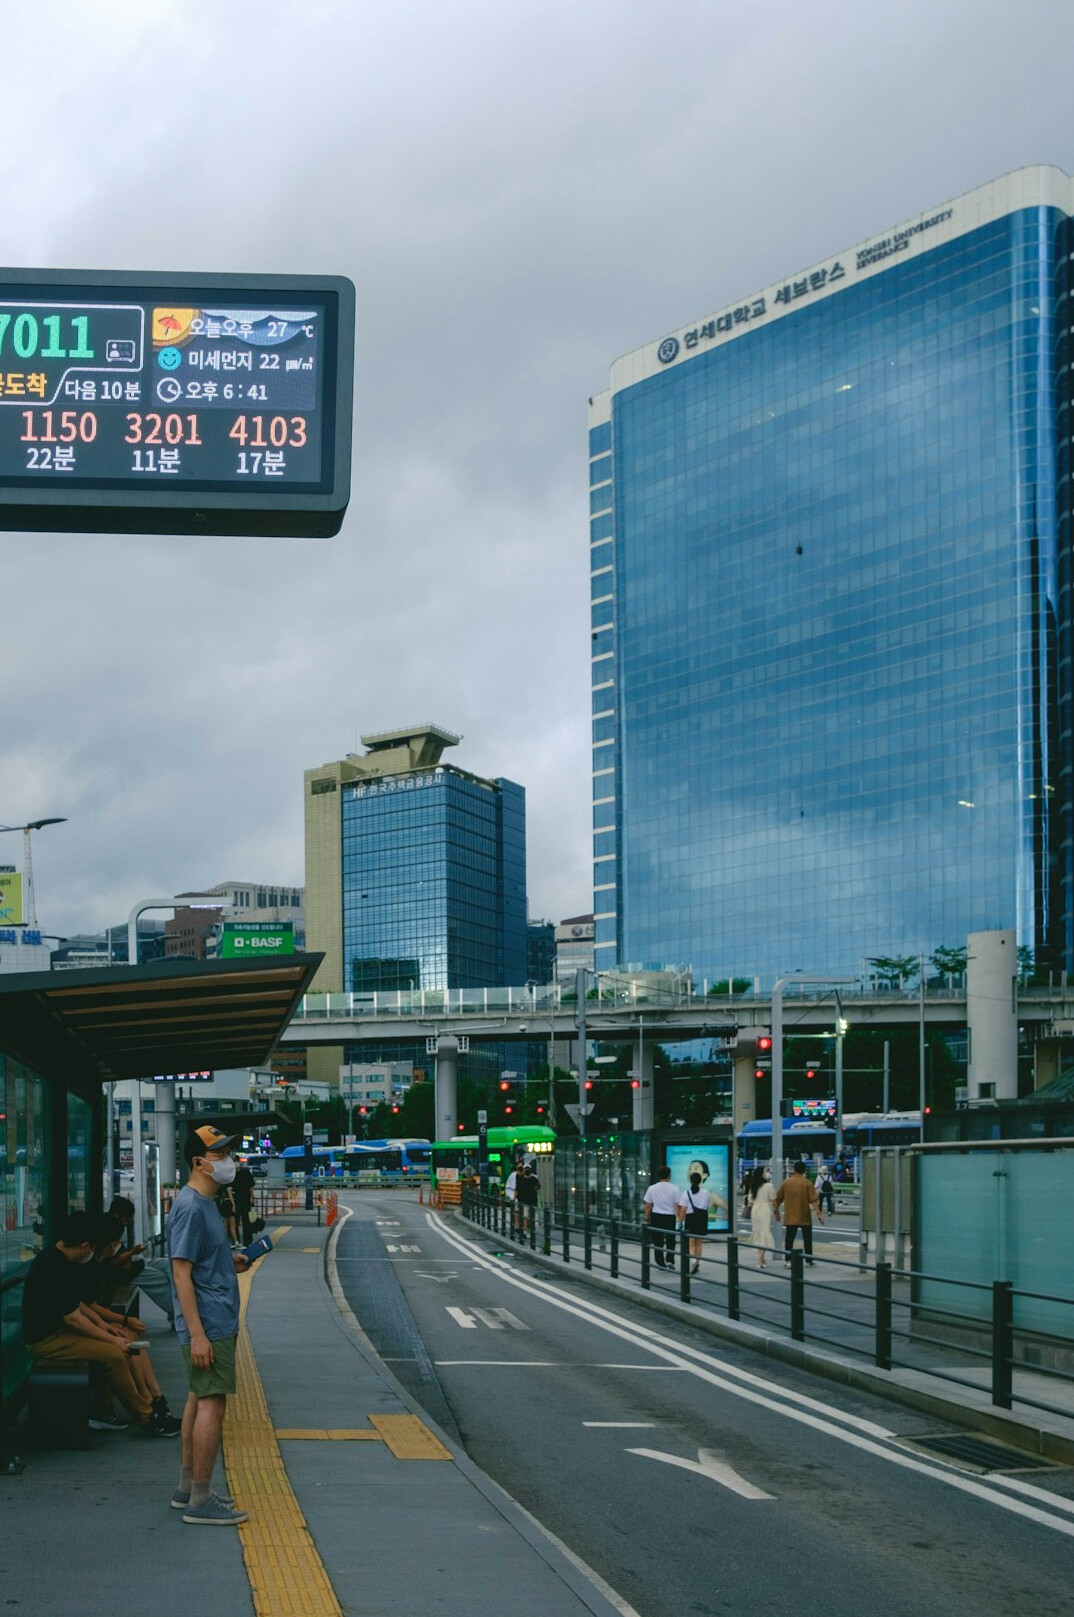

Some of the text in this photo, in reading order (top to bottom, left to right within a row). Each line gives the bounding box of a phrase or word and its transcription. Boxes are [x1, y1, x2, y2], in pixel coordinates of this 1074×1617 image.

[856, 208, 953, 260] YONSEI UNIVERSITY
[856, 240, 909, 270] SEVERANCE
[683, 261, 846, 349] 연세대학교 세브란스
[267, 321, 288, 337] 27
[188, 349, 253, 371] 미세먼지
[259, 353, 280, 370] 22
[0, 372, 48, 398] 도착
[65, 379, 97, 401] 다음
[185, 380, 219, 402] 오후
[20, 410, 97, 443] 1150
[124, 412, 202, 446] 3201
[228, 415, 307, 447] 4103
[26, 445, 76, 471] 22분
[131, 447, 181, 474] 11분
[236, 450, 286, 476] 17분
[352, 773, 442, 799] HF 한국주택금융공사
[251, 937, 283, 947] BASF
[305, 1137, 312, 1146] 5
[479, 1125, 487, 1134] 6
